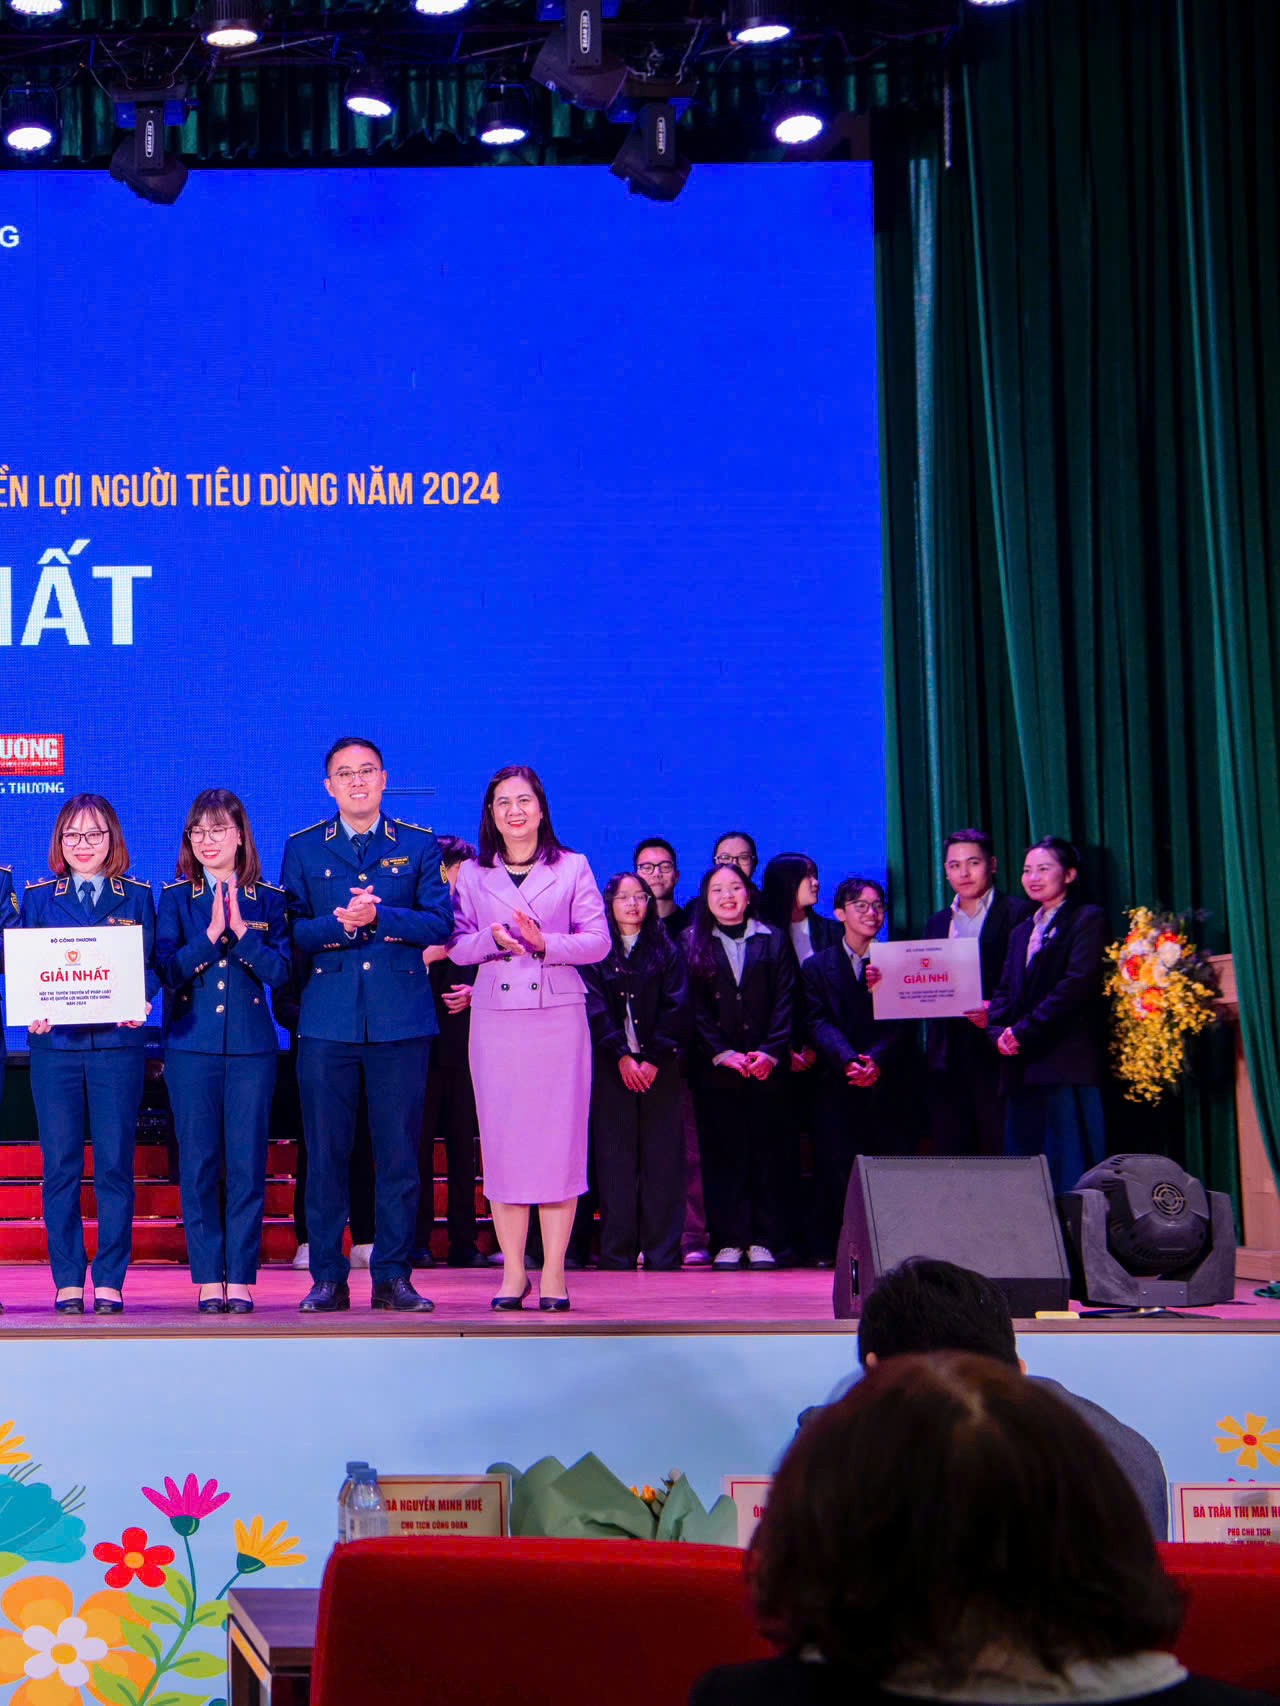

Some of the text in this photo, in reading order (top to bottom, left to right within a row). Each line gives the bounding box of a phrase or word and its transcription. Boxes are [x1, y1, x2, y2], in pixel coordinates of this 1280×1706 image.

[39, 472, 80, 515] LỢI
[92, 467, 176, 507] NGƯỜI
[186, 466, 250, 506] TIÊU
[260, 466, 337, 506] DÙNG
[348, 465, 413, 504] NĂM
[423, 472, 500, 504] 2024
[8, 781, 65, 794] THƯƠNG
[40, 966, 111, 983] GIẢI NHẤT
[903, 971, 949, 984] GIẢI NHÌ
[400, 1496, 436, 1512] NGUYỄN
[438, 1499, 462, 1512] MINH
[1234, 1506, 1249, 1520] THỊ
[1251, 1506, 1269, 1518] MAI
